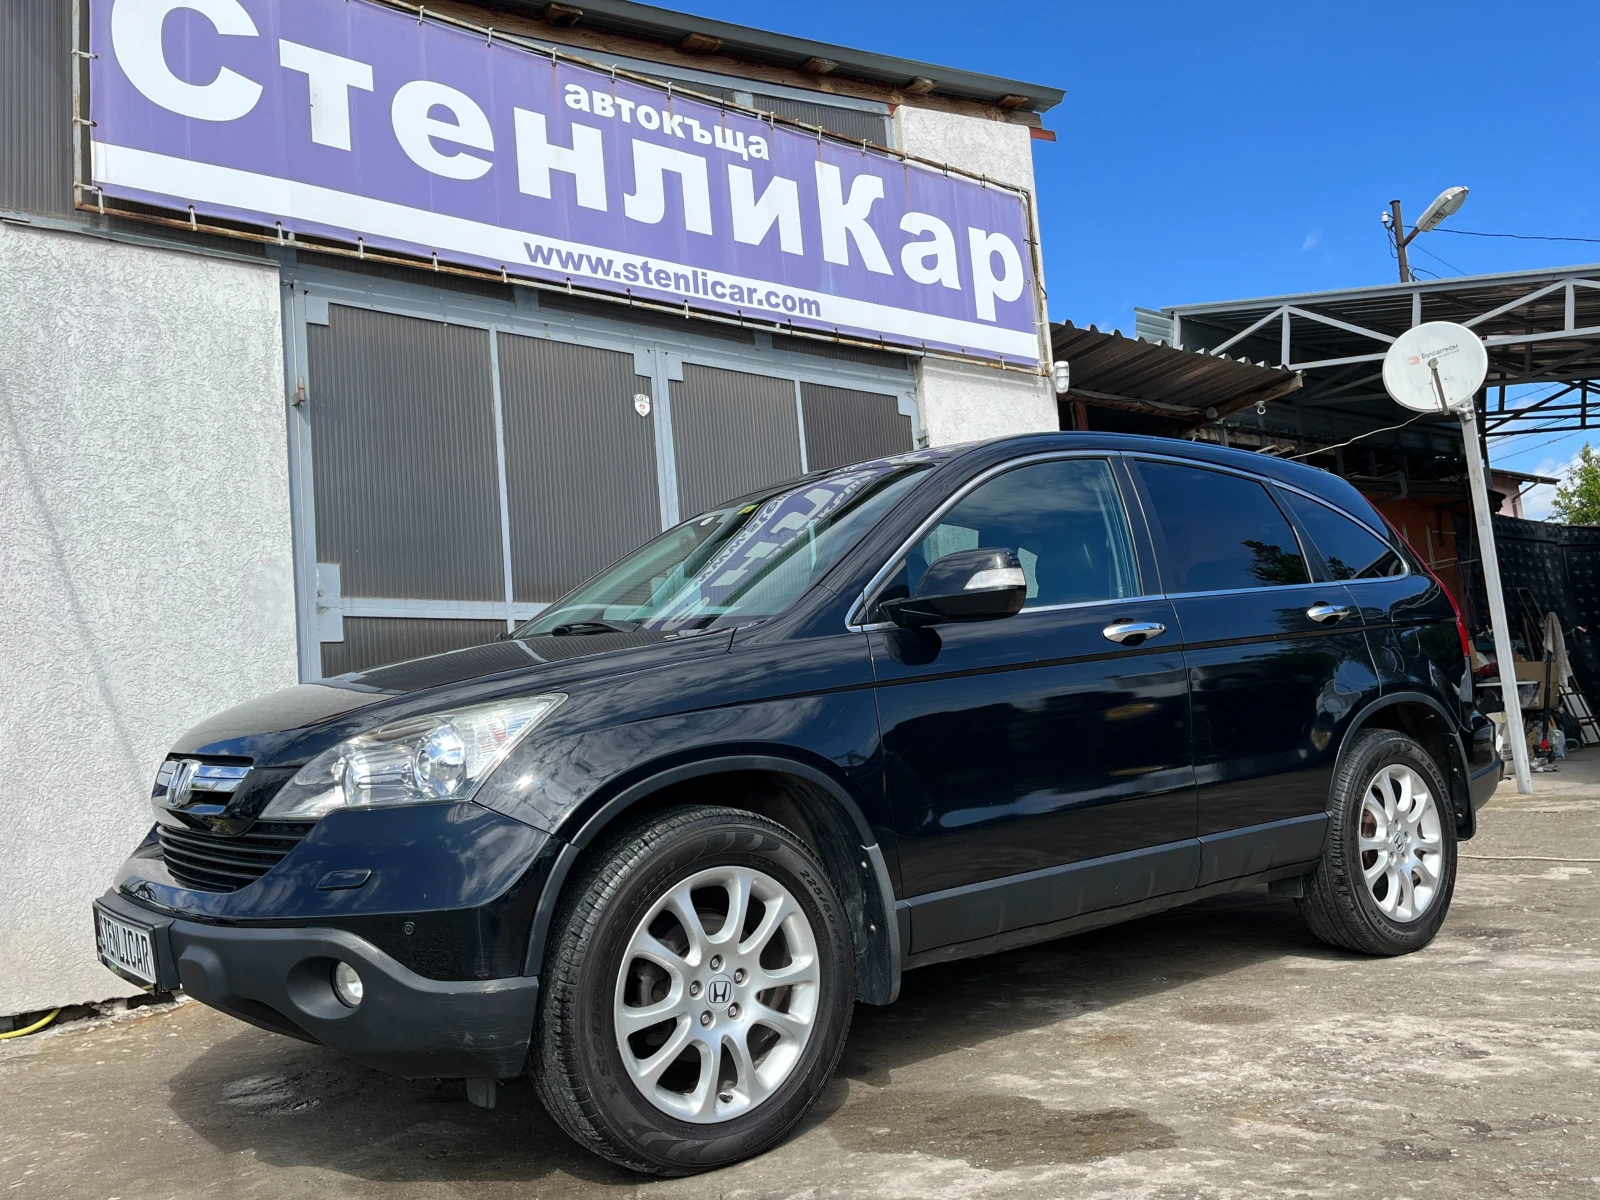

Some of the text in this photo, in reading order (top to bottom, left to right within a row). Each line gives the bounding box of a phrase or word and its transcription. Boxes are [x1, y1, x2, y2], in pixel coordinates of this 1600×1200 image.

[564, 84, 770, 161] автокъща
[523, 241, 822, 318] www.stenlicar.com
[100, 914, 151, 977] STENLICAR
